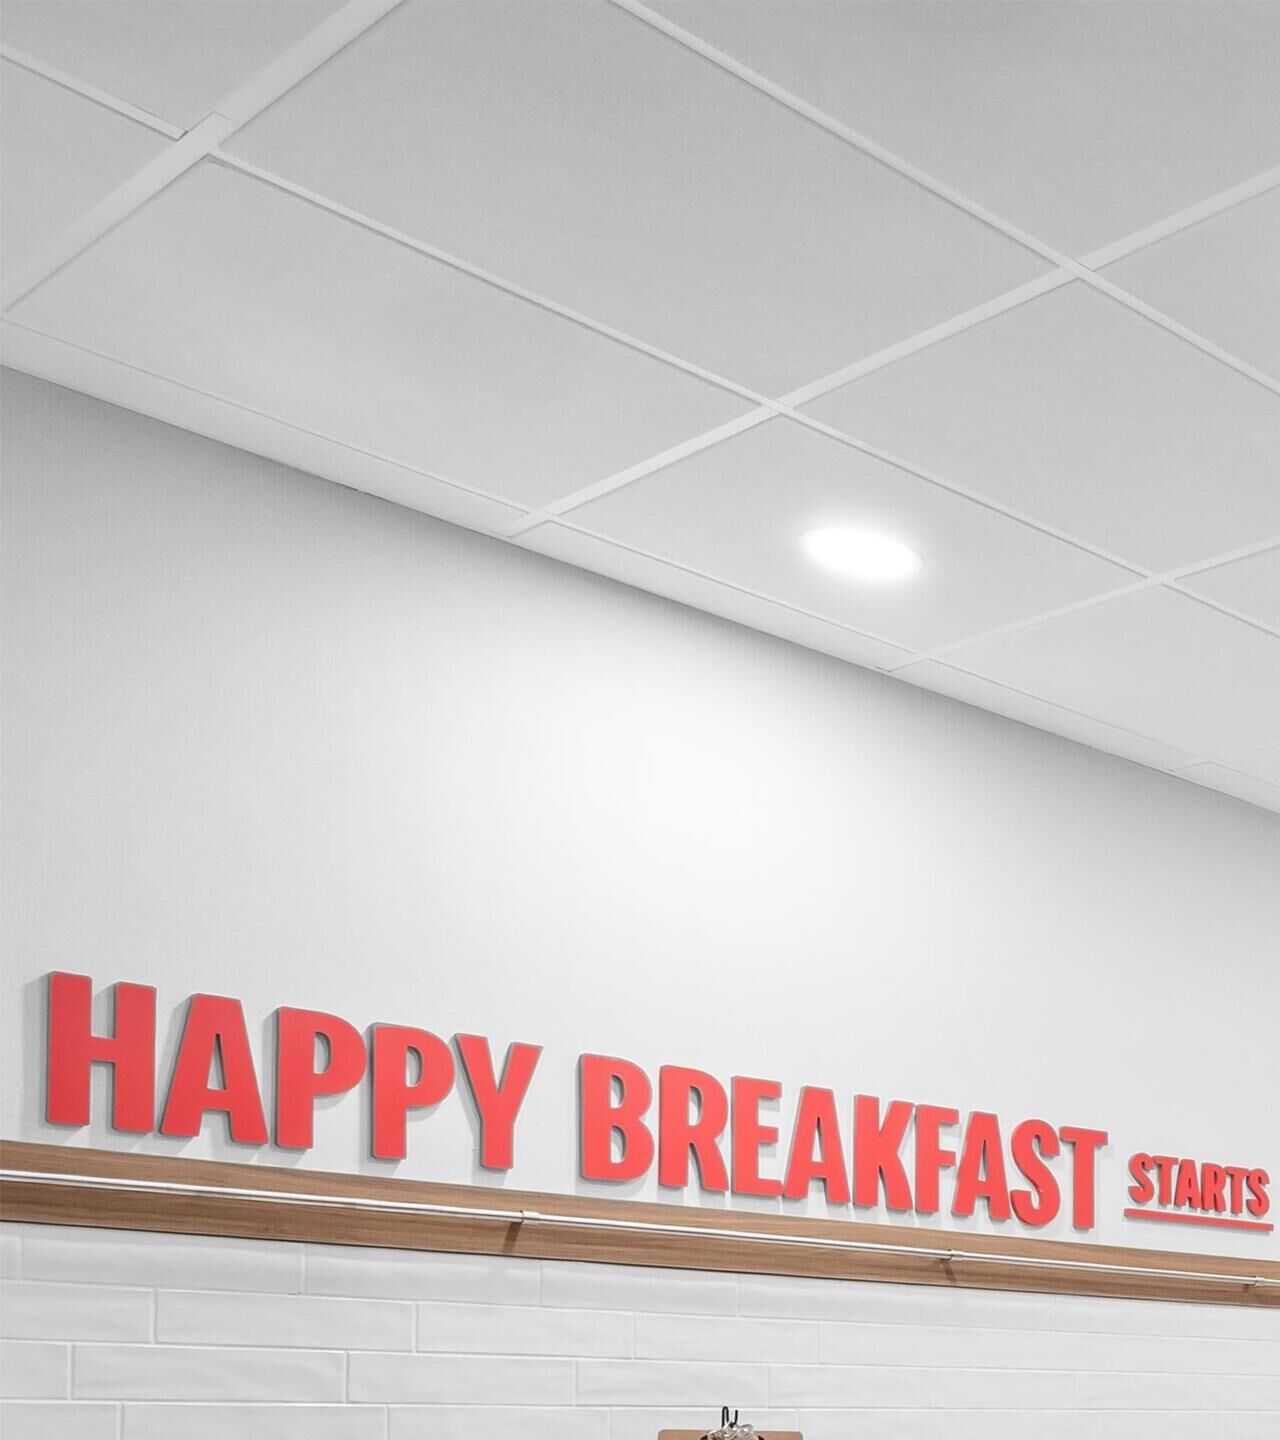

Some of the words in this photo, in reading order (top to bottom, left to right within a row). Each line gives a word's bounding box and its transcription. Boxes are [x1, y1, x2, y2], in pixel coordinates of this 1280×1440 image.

[46, 971, 543, 1170] HAPPY
[579, 1053, 1108, 1230] BREAKFAST
[1128, 1153, 1271, 1216] STARTS
